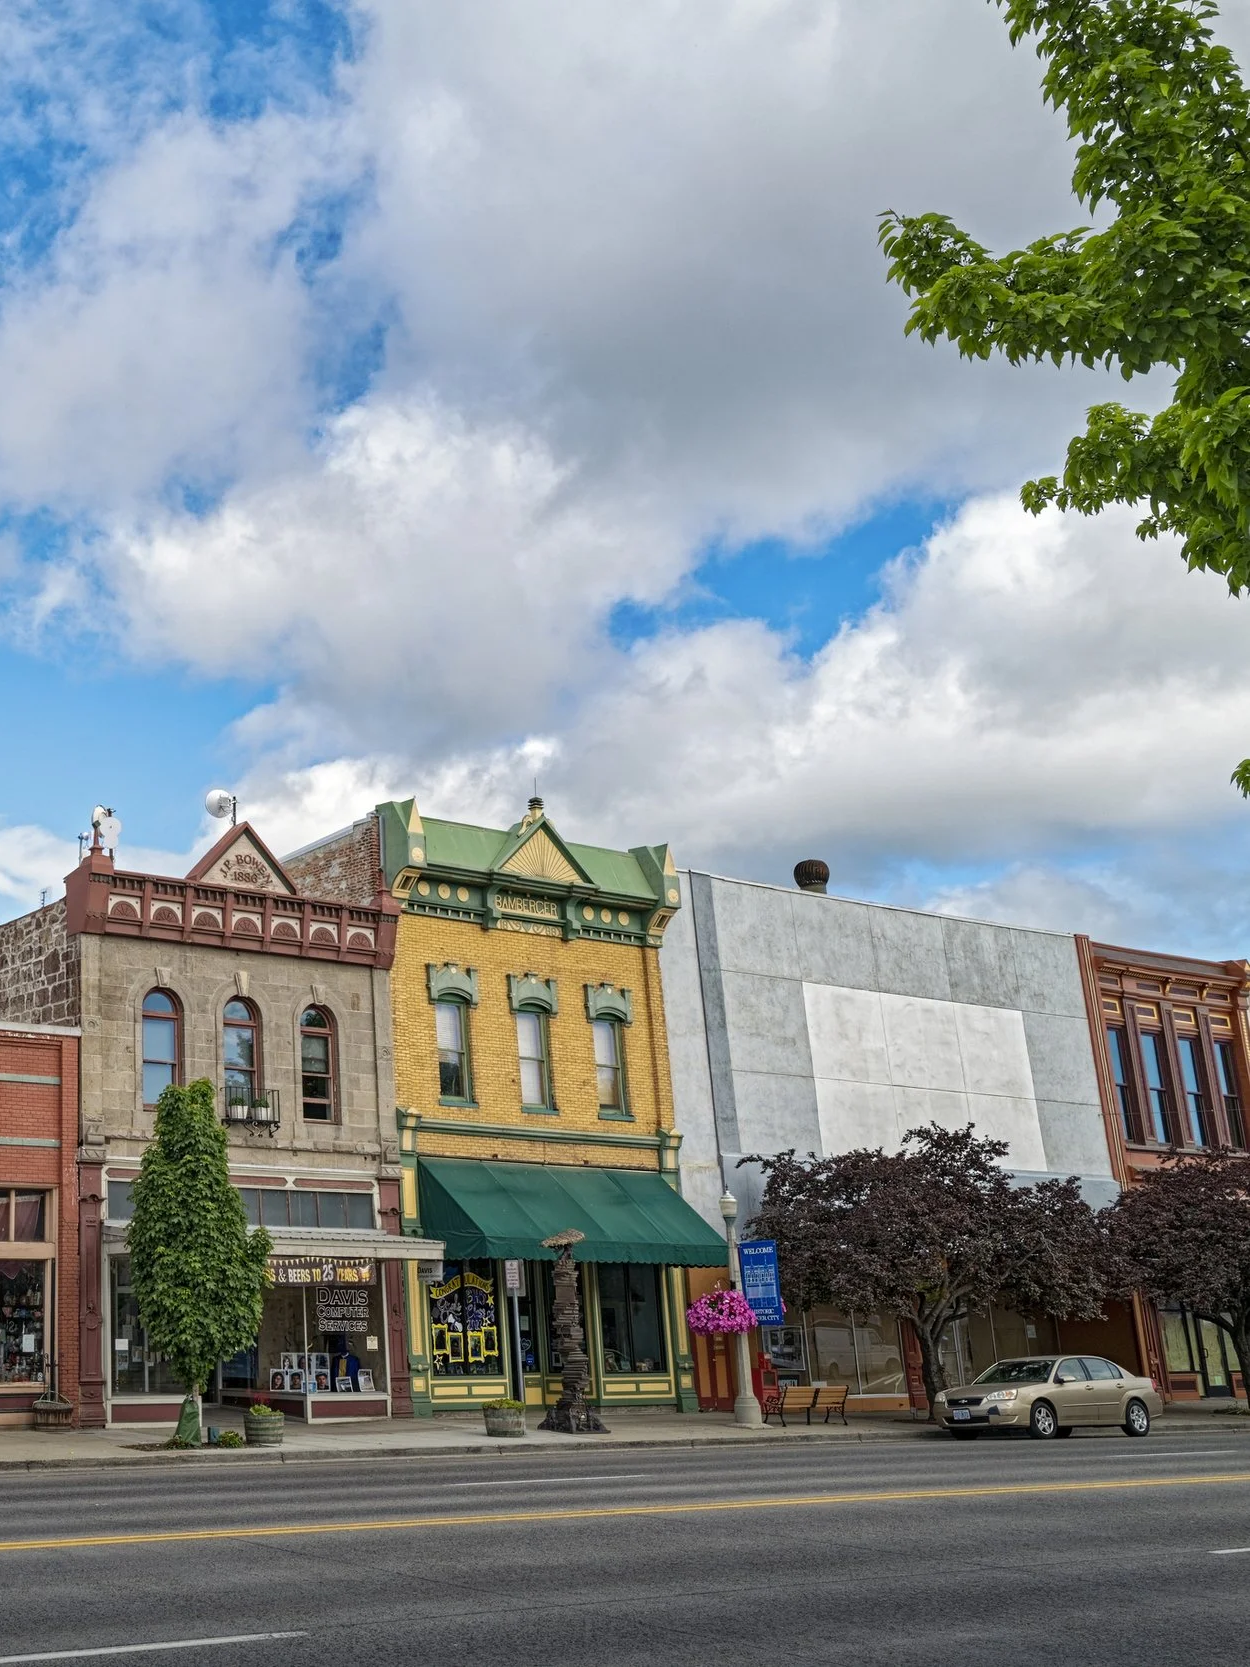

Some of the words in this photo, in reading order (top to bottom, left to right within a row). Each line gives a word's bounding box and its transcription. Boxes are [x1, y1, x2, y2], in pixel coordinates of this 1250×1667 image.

[235, 855, 273, 884] BOWEN
[233, 871, 258, 884] 1886
[494, 894, 558, 917] BAMBERGER
[743, 1246, 774, 1255] WELCOME
[278, 1267, 286, 1283] &
[288, 1268, 311, 1283] BEERS
[312, 1268, 321, 1282] TO
[322, 1264, 334, 1281] 25
[336, 1268, 359, 1282] YEARS
[417, 1266, 433, 1274] DAVIS
[316, 1286, 369, 1305] DAVIS
[316, 1305, 369, 1318] COMPUTER
[318, 1318, 368, 1332] SERVICES
